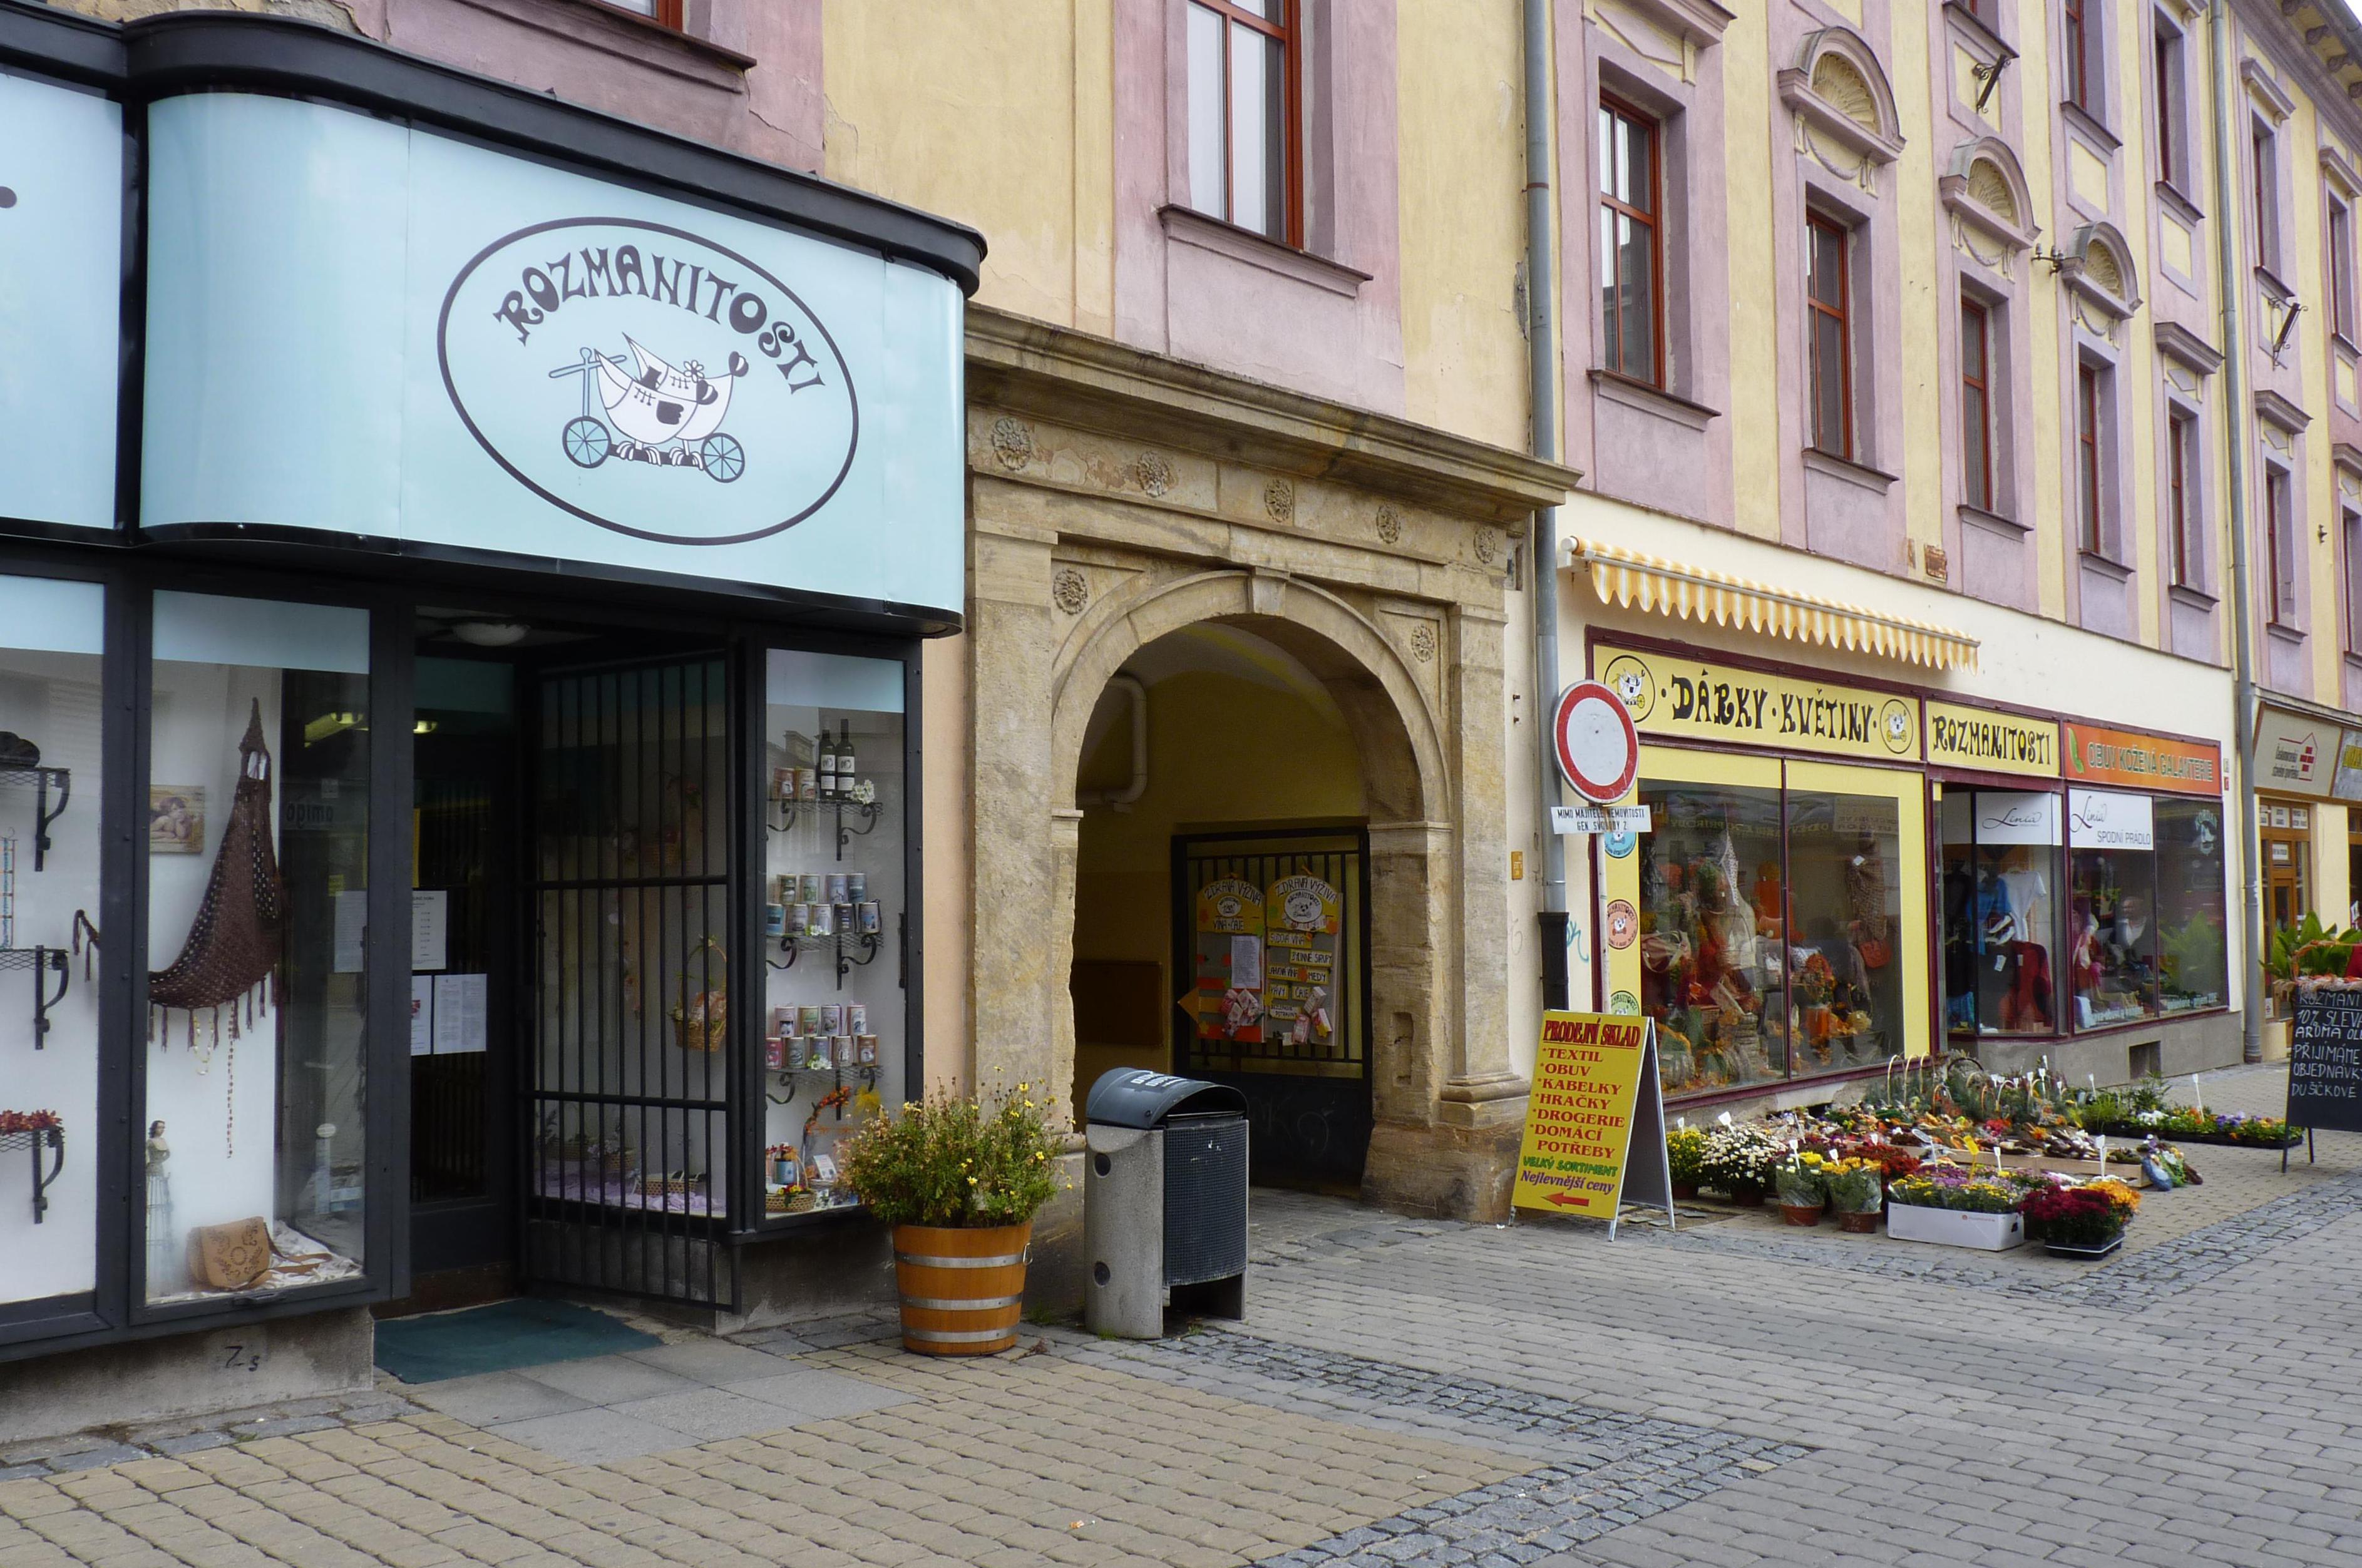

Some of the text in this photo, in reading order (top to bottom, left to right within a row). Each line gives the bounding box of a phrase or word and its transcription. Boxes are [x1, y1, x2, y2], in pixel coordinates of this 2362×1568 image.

[493, 245, 826, 395] ROZMANITOSTI
[1671, 669, 1874, 743] DÁRKY KVĚTINY
[1932, 715, 2051, 766] ROZMANITOSTI
[2087, 742, 2213, 782] OBUV KOŽENÁ GALANTERIE
[1558, 807, 1645, 818] MIMO MAJITELE NEMOVITOSTI
[2097, 829, 2151, 845] SPODNÍ PRÁDLO
[1308, 971, 1326, 981] MEDY
[2299, 992, 2362, 1007] ROZMANI
[2298, 1009, 2319, 1027] 10%
[1543, 1017, 1641, 1047] PRODEJNÍ SKLAD
[2295, 1026, 2341, 1040] AROMA
[1537, 1140, 1616, 1159] POTŘEBY
[1523, 1156, 1618, 1177] VELKÝ SORTIMENT
[1520, 1170, 1615, 1195] Nejlevnější ceny
